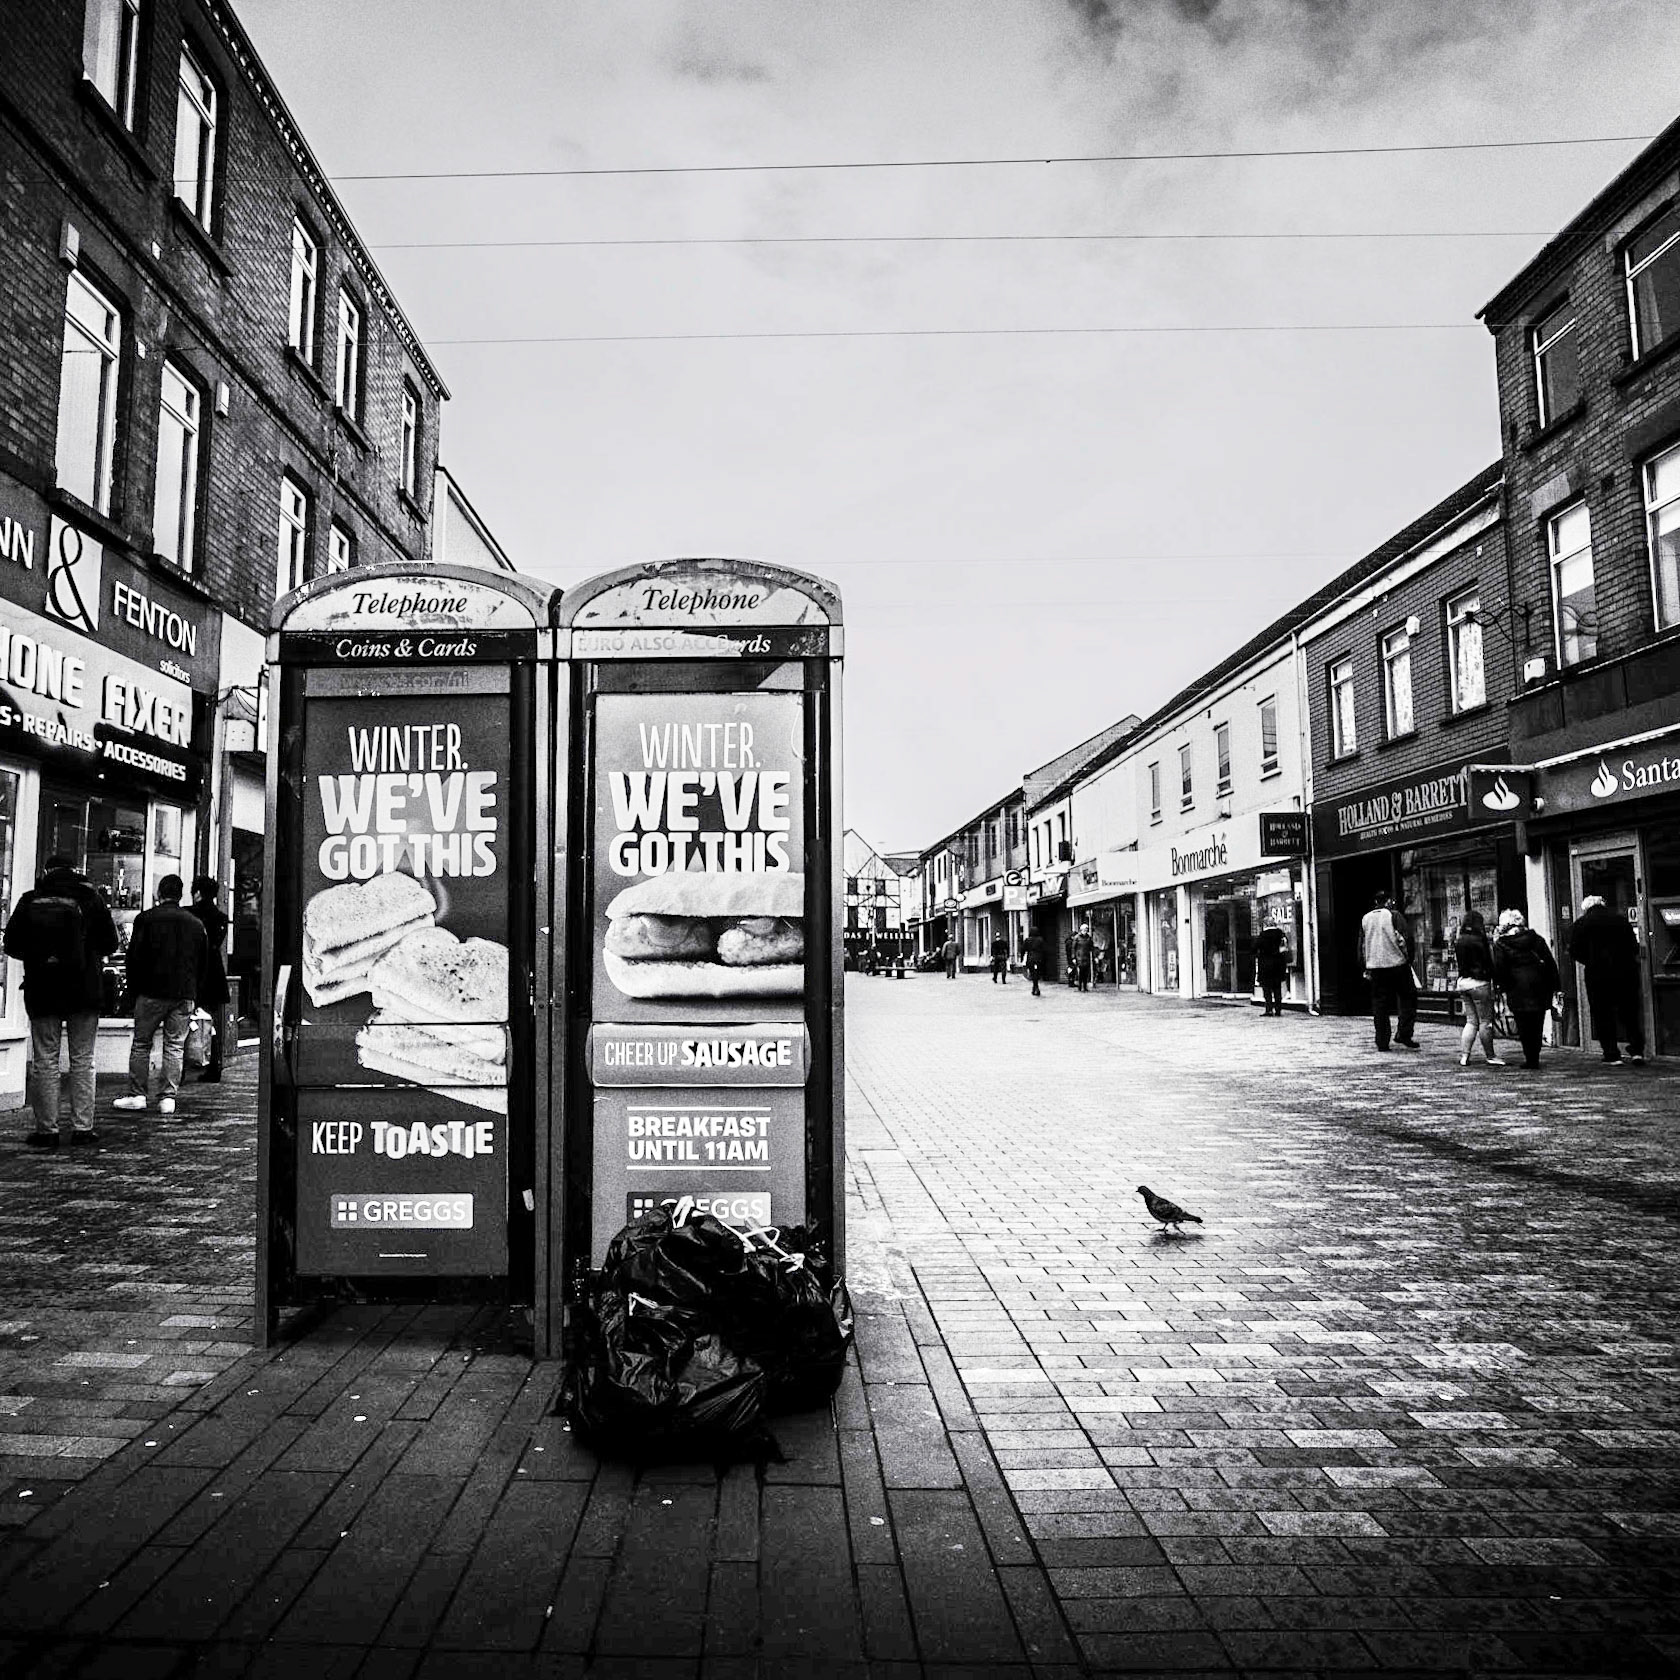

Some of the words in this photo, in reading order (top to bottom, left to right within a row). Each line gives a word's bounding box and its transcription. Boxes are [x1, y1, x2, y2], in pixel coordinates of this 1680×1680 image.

[50, 525, 99, 632] &
[114, 580, 197, 657] FENTON
[352, 593, 468, 618] Telephone
[642, 588, 759, 614] Telephone
[335, 639, 391, 657] Coins
[394, 639, 413, 656] &
[418, 638, 477, 657] Cards
[578, 637, 624, 652] EURO
[631, 636, 675, 651] ALSO
[716, 634, 771, 653] rds
[160, 660, 190, 684] solicitors
[103, 673, 192, 748] FIXER
[23, 712, 93, 753] REPAIRS
[104, 740, 186, 781] ACCESSORIES
[348, 723, 468, 772] WINTER.
[639, 722, 761, 768] WINTER.
[318, 771, 498, 834] WE'VE
[608, 770, 790, 831] WE'VE
[1337, 796, 1389, 836] HOLLAND
[1391, 792, 1402, 823] &
[1404, 773, 1468, 815] BARRETT
[318, 833, 400, 880] GOT
[408, 832, 497, 877] THIS
[608, 831, 693, 877] GOT
[700, 831, 790, 873] THIS
[1171, 832, 1228, 876] Bonmarché
[1272, 905, 1293, 924] SALE
[866, 931, 914, 940] JWELLERS
[604, 1042, 653, 1066] CHEER
[657, 1042, 678, 1066] UP
[681, 1039, 792, 1068] SAUSAGE
[312, 1121, 363, 1154] KEEP
[370, 1120, 494, 1160] TOASTIE
[628, 1116, 770, 1137] BREAKFAST
[628, 1139, 699, 1160] UNTIL
[705, 1139, 769, 1160] 11AM
[363, 1200, 466, 1221] GREGGS
[660, 1197, 764, 1219] EGGS
